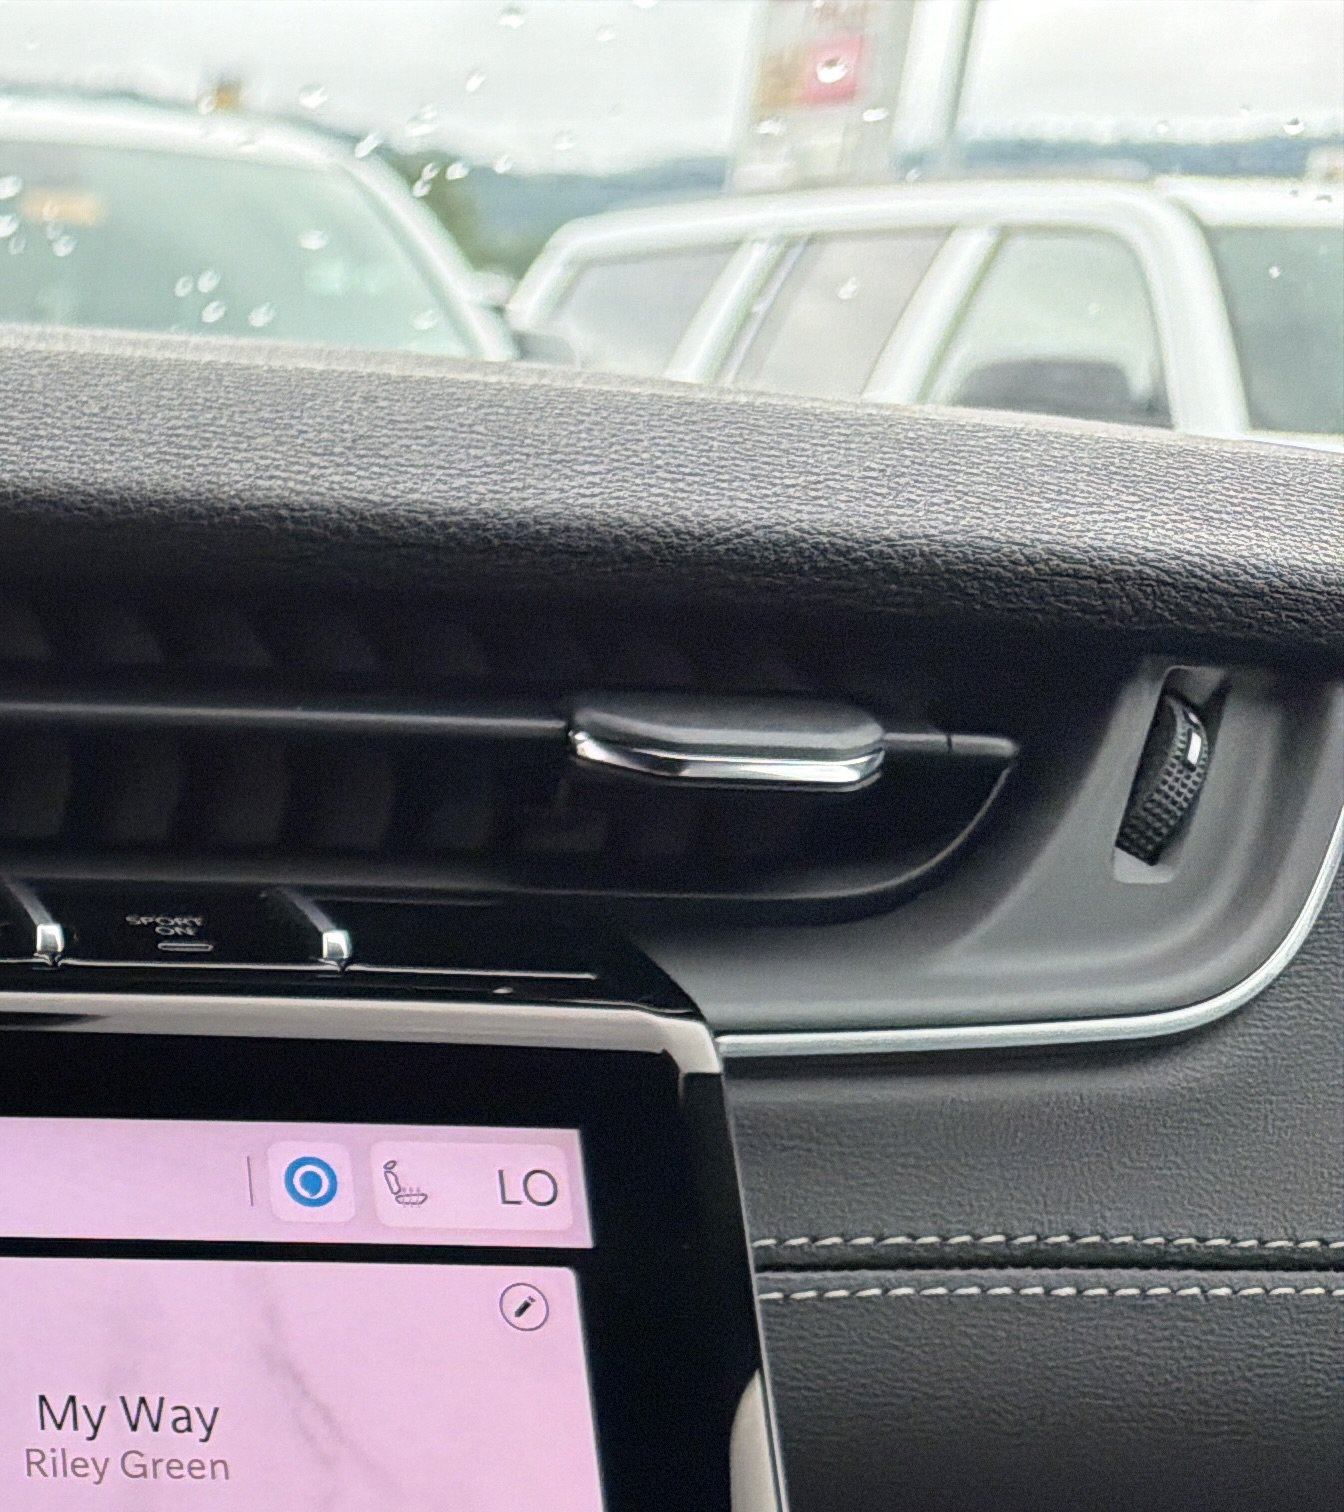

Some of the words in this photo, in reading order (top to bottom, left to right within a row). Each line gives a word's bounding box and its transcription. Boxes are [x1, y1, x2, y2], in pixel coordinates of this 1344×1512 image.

[125, 915, 204, 927] SPORT
[155, 926, 198, 937] ON
[498, 1169, 559, 1208] LO
[37, 1395, 106, 1438] My
[120, 1396, 220, 1443] Way
[25, 1447, 109, 1485] Riley
[121, 1449, 230, 1481] Green
